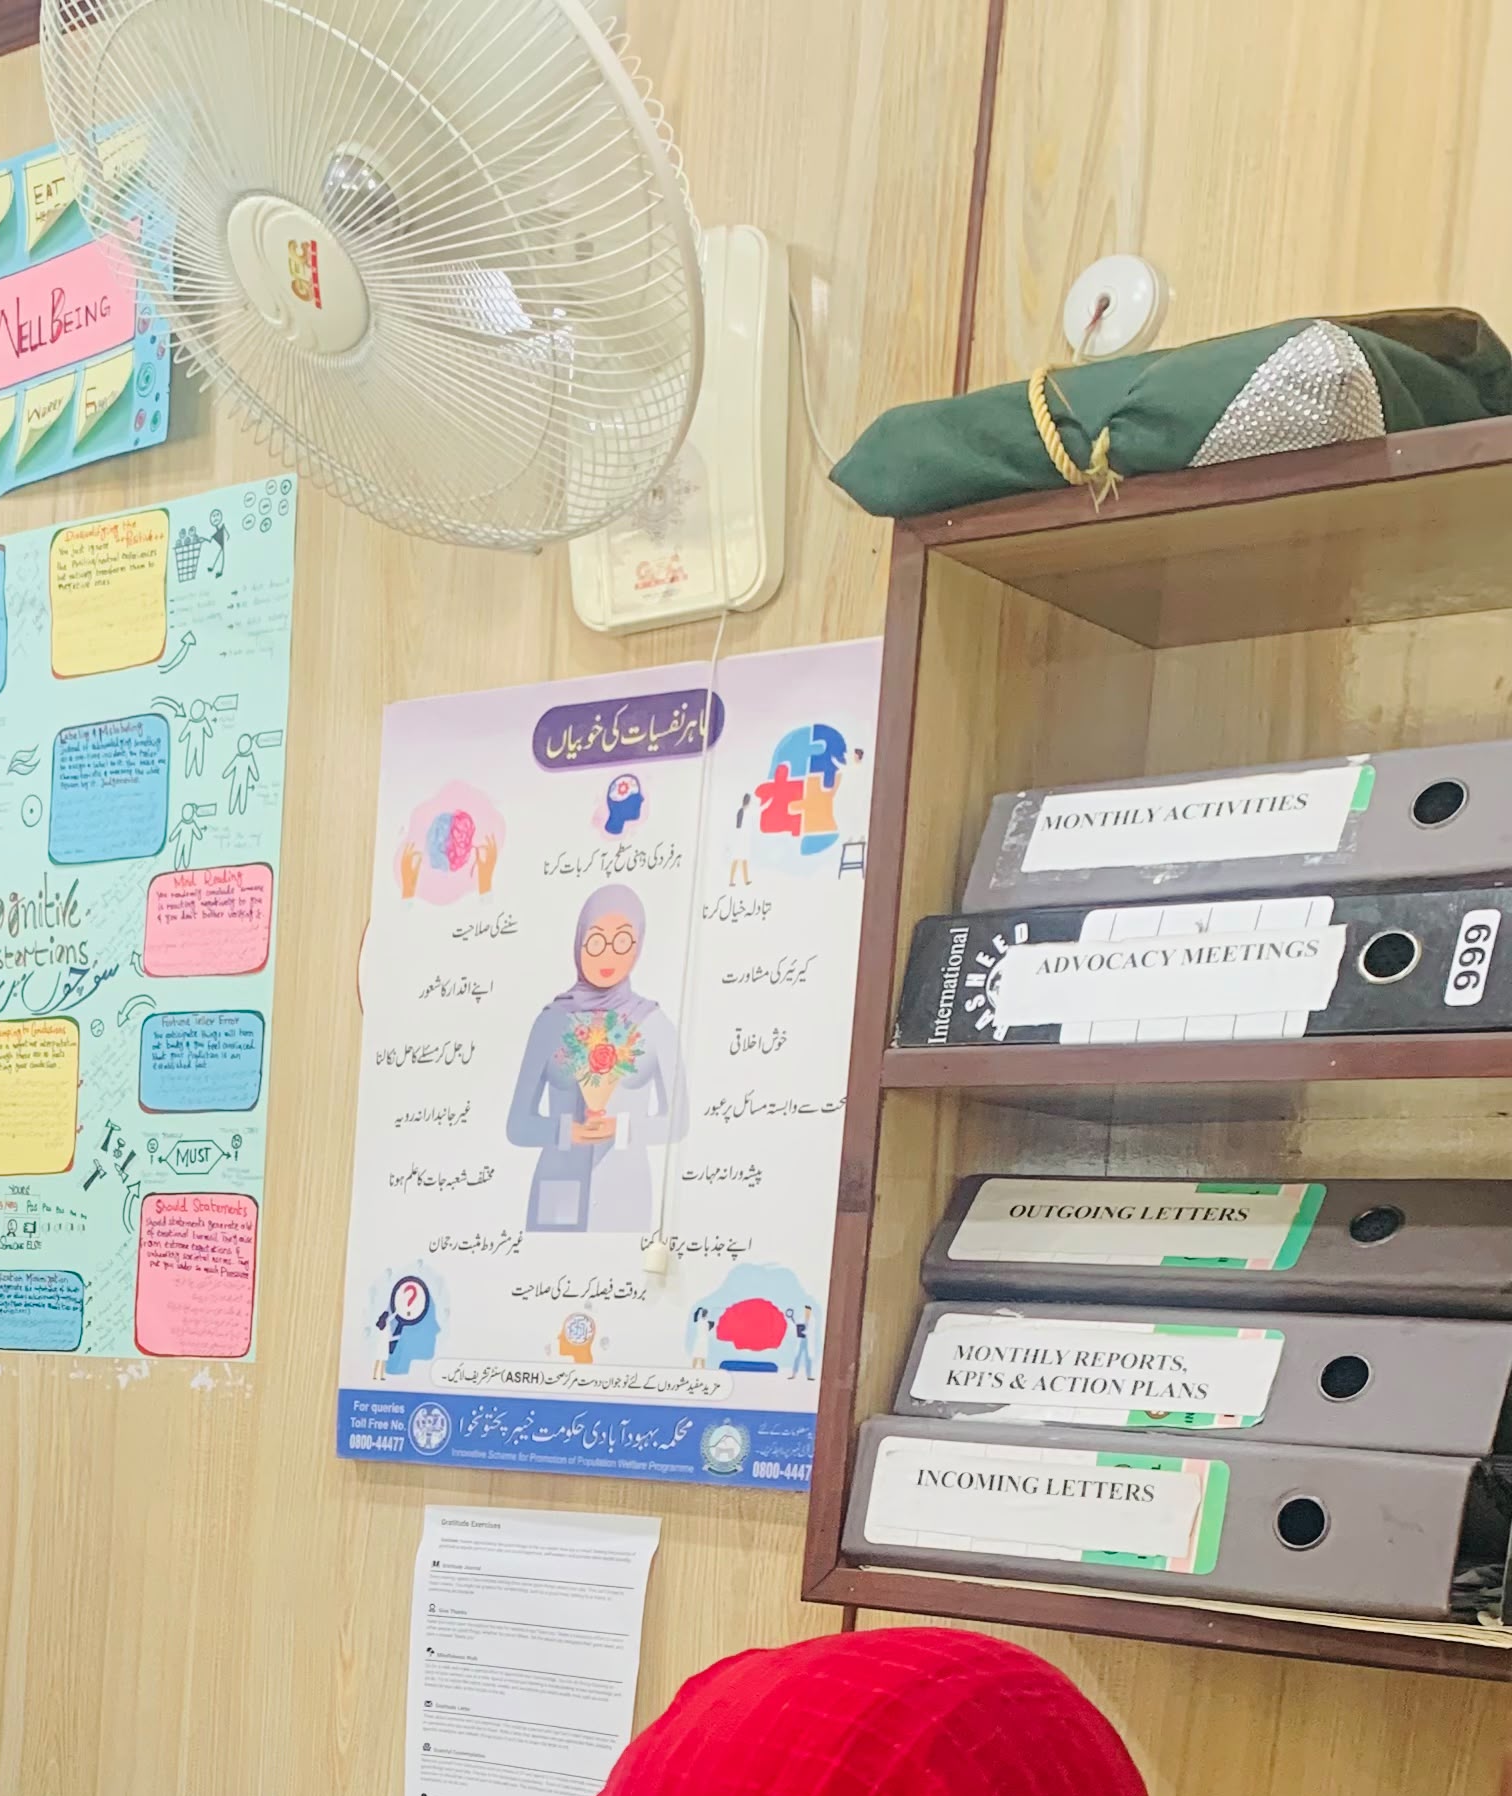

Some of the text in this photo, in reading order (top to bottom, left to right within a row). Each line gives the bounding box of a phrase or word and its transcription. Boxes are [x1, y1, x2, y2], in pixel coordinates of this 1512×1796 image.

[33, 177, 65, 205] EAT
[1039, 791, 1310, 833] MONTHLY ACTIVITIES
[1036, 937, 1320, 978] ADVOCACY MEETINGS
[927, 927, 970, 1044] International
[176, 1147, 212, 1167] MUST
[1008, 1202, 1251, 1224] OUTGOING LETTERS
[953, 1343, 1189, 1375] MONTHLY REPORTS,
[1009, 1371, 1028, 1389] &
[1031, 1374, 1125, 1396] ACTION
[1131, 1377, 1210, 1401] PLANS
[353, 1400, 405, 1414] For queries
[350, 1417, 367, 1429] Toll
[349, 1434, 405, 1452] 0800-44477
[915, 1467, 1156, 1504] INCOMING LETTERS
